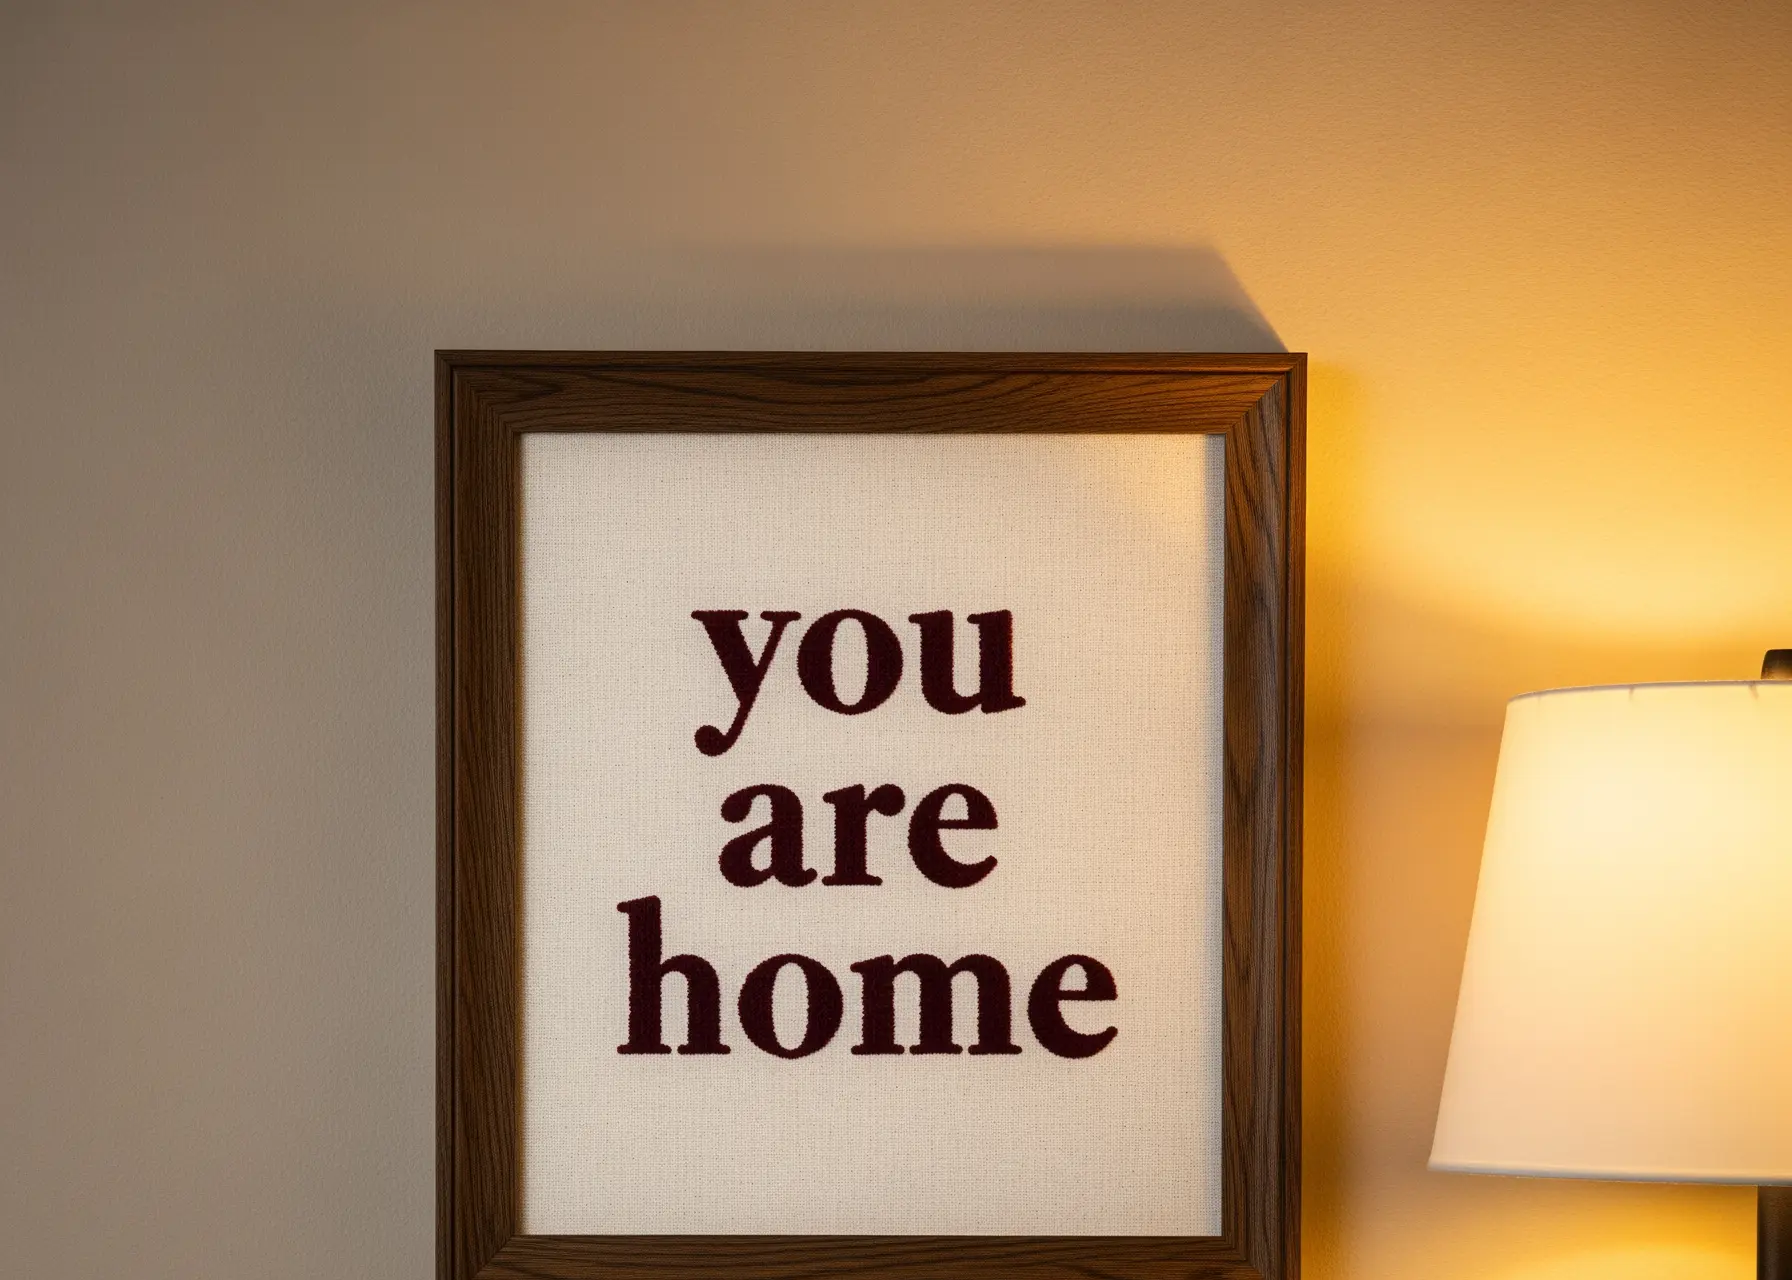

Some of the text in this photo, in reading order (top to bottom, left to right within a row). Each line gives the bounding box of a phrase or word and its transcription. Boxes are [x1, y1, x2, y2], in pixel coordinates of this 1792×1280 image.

[690, 608, 1028, 758] you
[717, 782, 1000, 890] are
[615, 893, 1120, 1062] home
